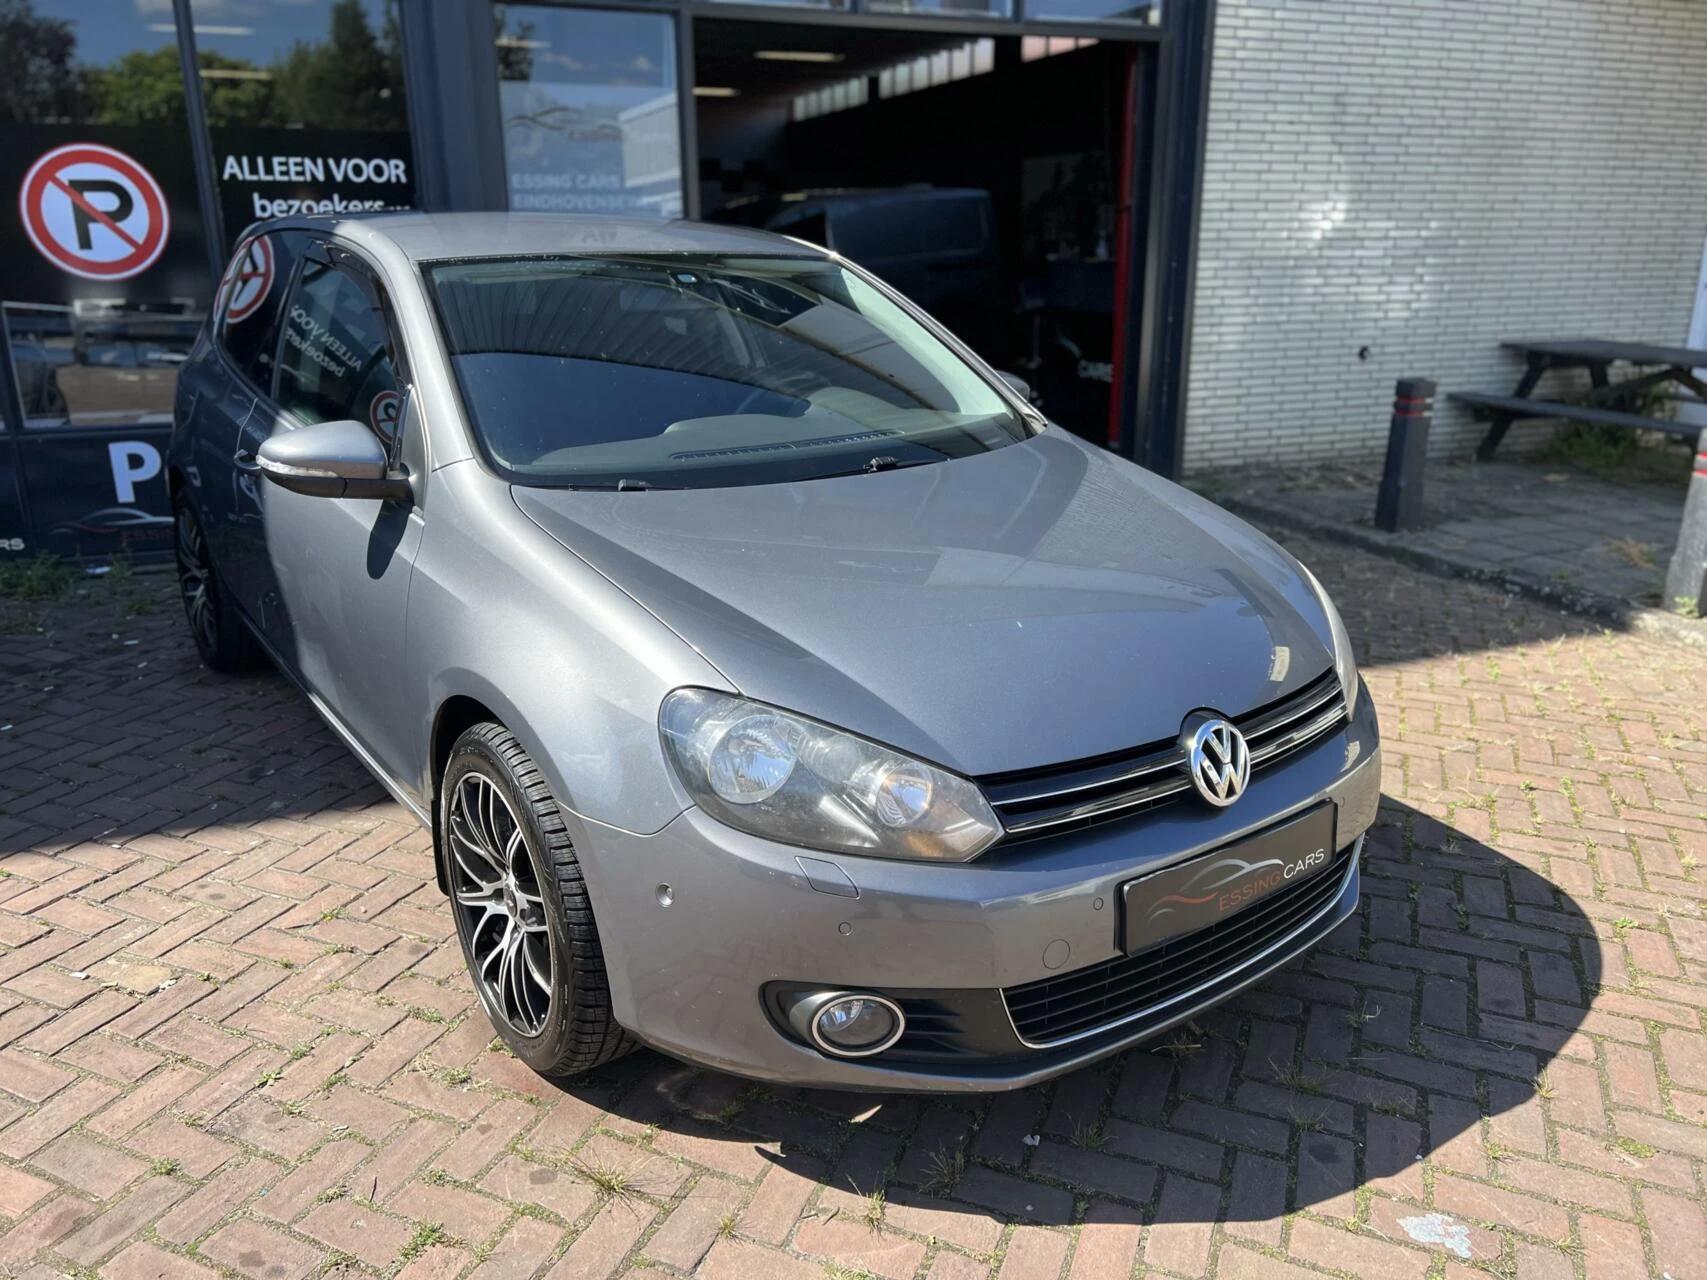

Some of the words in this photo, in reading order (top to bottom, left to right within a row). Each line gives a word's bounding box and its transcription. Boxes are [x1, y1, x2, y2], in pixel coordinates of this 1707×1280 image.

[223, 155, 325, 182] ALLEEN
[327, 157, 407, 184] VOOR
[68, 179, 133, 250] P
[108, 440, 162, 503] P
[1219, 870, 1282, 912] ESSING
[1283, 848, 1325, 880] CARS
